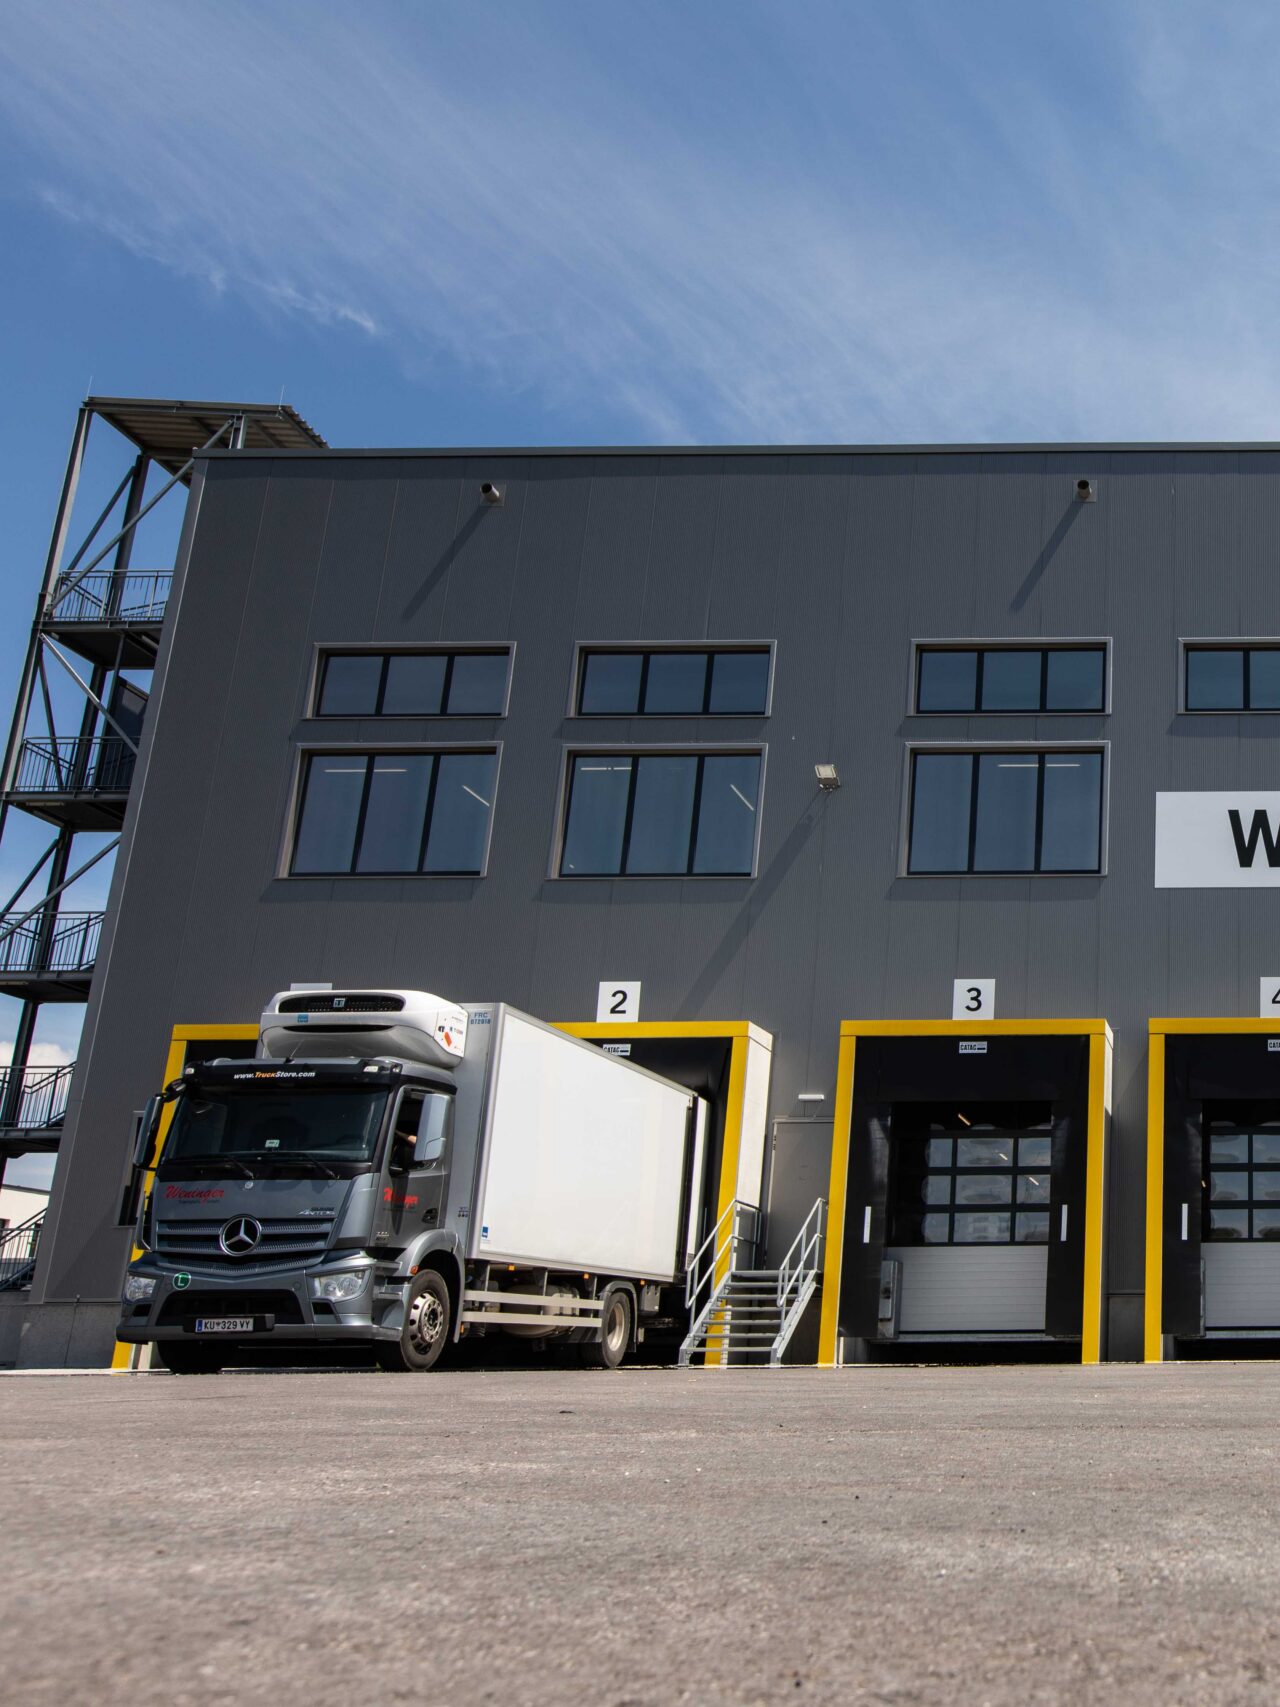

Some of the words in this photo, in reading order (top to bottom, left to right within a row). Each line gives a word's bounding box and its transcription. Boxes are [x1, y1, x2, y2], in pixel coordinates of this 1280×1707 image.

[609, 989, 628, 1015] 2
[965, 987, 982, 1012] 3
[177, 1275, 185, 1286] L
[204, 1320, 215, 1330] KU
[220, 1320, 238, 1329] 329
[239, 1320, 251, 1329] VY
